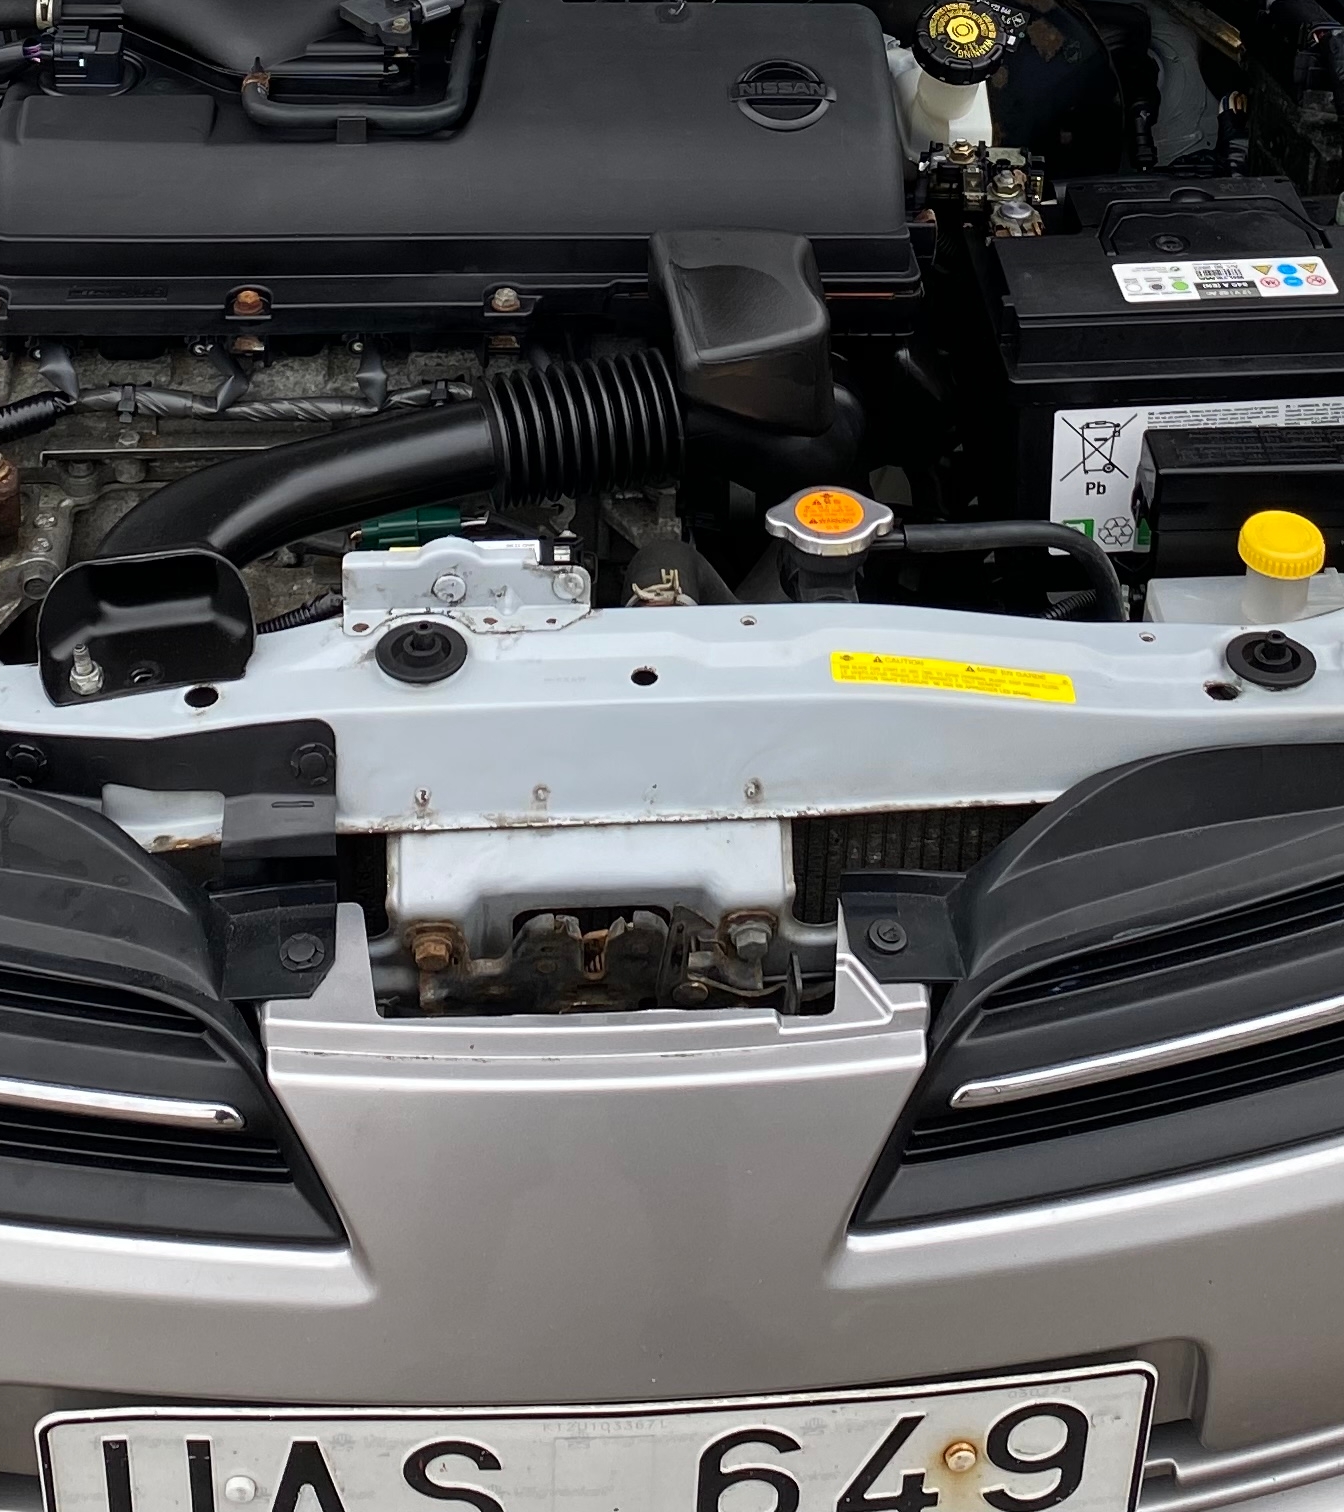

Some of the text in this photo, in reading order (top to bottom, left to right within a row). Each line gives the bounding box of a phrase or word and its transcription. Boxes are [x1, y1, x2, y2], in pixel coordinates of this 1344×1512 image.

[738, 81, 826, 97] NISSAN
[1085, 481, 1107, 496] Pb
[696, 1402, 1090, 1512] 649
